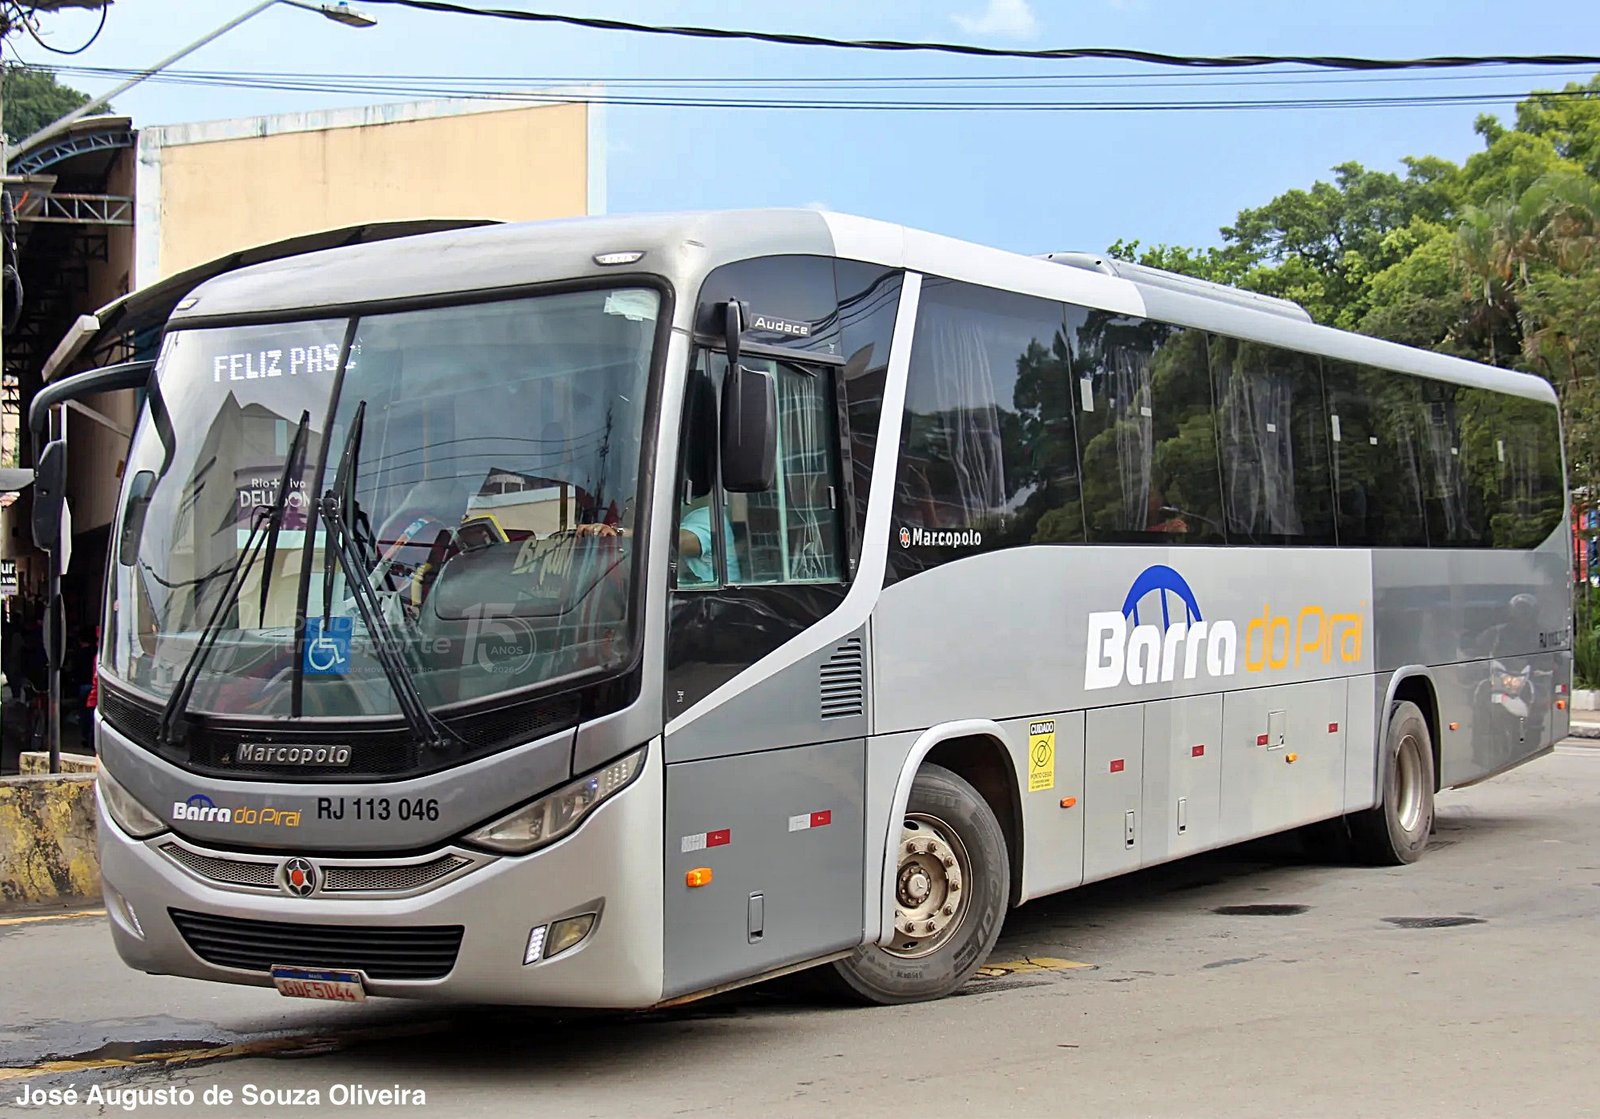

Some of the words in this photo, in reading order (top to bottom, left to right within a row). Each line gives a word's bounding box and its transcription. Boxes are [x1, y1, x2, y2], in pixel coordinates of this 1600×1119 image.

[754, 317, 808, 335] Audace
[213, 349, 283, 382] FELIZ
[912, 527, 982, 549] Marcopolo
[1084, 610, 1238, 691] Barra
[1244, 602, 1291, 673] do
[1031, 722, 1053, 734] CUIDADO
[239, 743, 349, 765] Marcopolo
[172, 801, 232, 823] Barra
[234, 806, 257, 824] do
[317, 797, 345, 820] RJ
[352, 797, 391, 821] 113
[398, 798, 440, 821] 046
